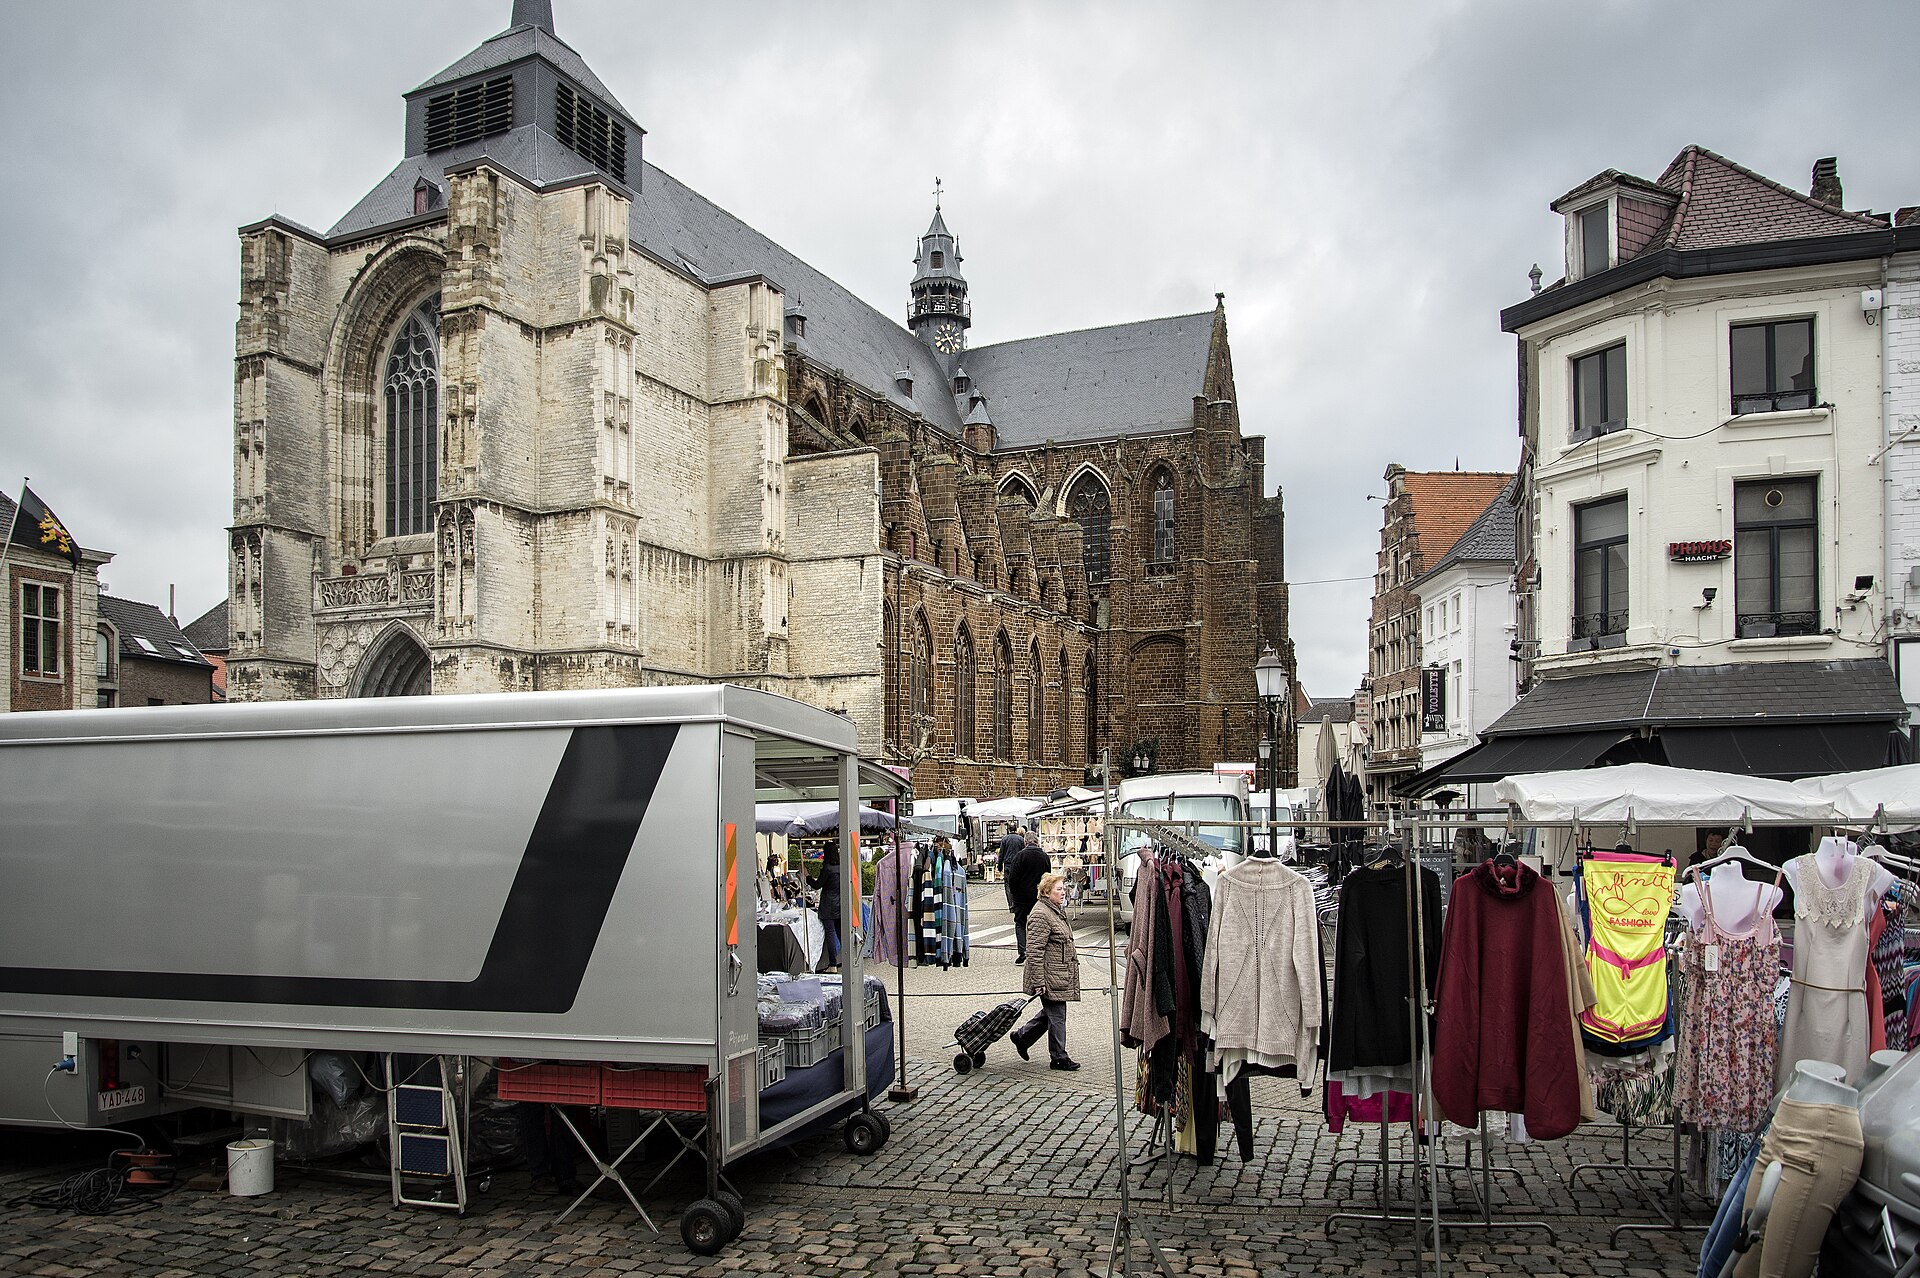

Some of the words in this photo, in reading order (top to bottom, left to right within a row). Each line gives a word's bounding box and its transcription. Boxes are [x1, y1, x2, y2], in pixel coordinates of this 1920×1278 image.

[1669, 540, 1733, 556] PRIMUS
[1429, 671, 1439, 714] VIOLETTE
[1609, 917, 1654, 928] FASHION
